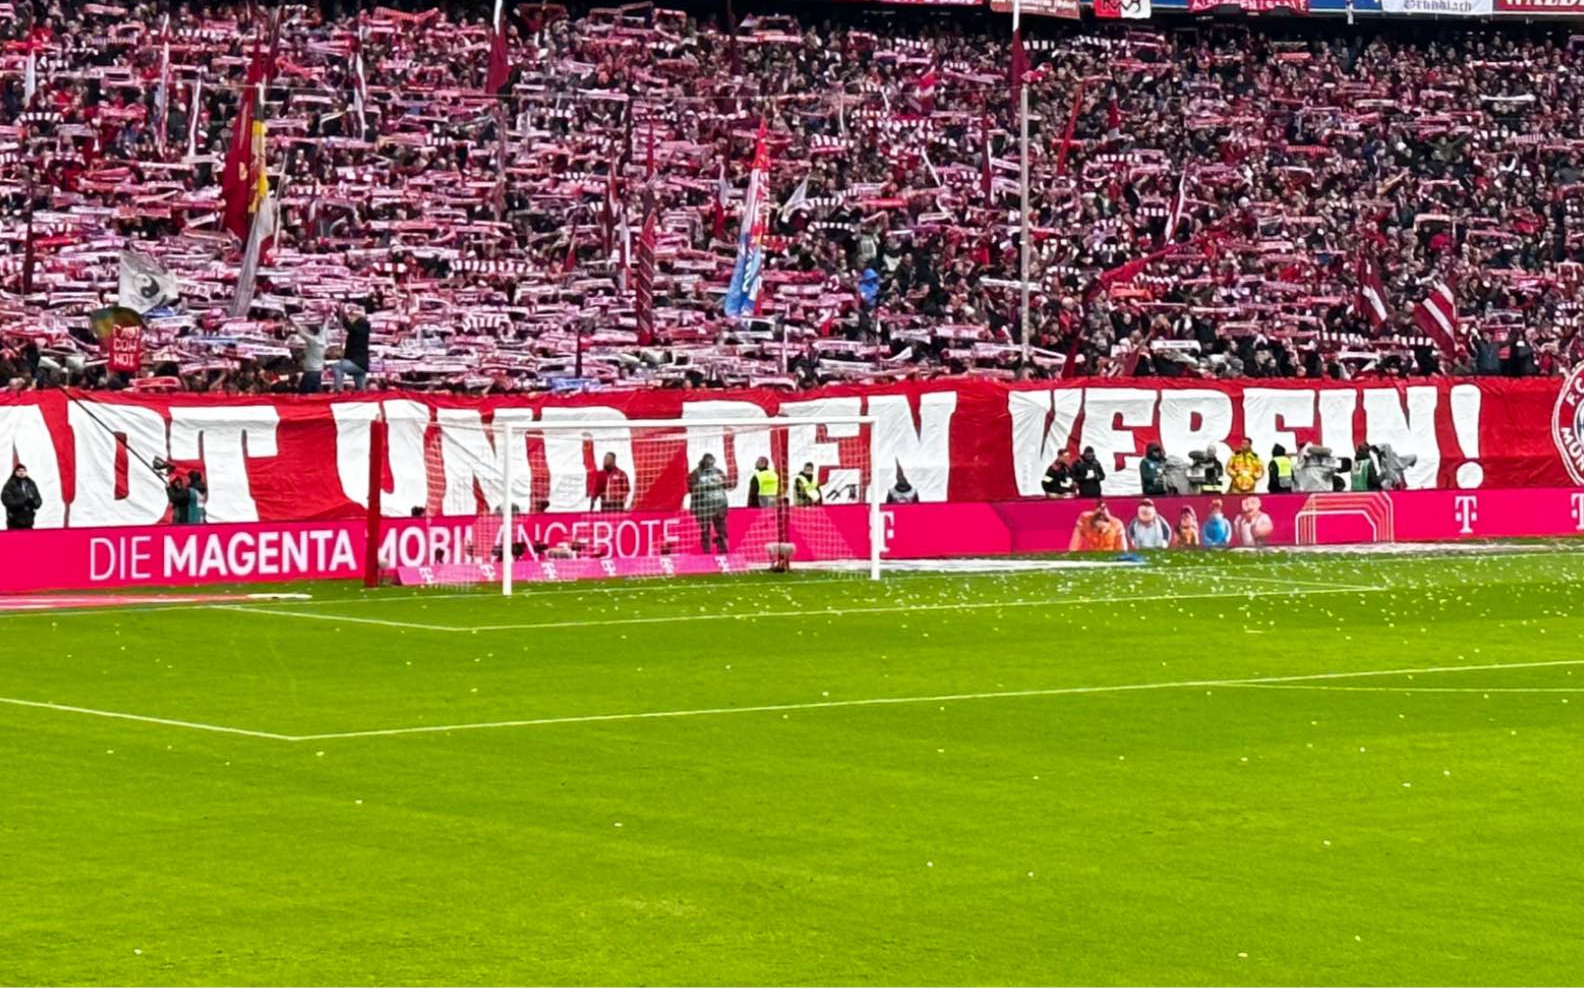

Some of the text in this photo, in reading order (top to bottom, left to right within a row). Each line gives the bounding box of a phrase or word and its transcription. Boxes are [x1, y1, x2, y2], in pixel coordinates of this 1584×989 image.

[330, 398, 635, 518] UND
[680, 391, 958, 507] DEN
[1008, 383, 1484, 498] VEREIN!
[89, 534, 152, 582] DIE
[162, 529, 358, 578] MAGENTA
